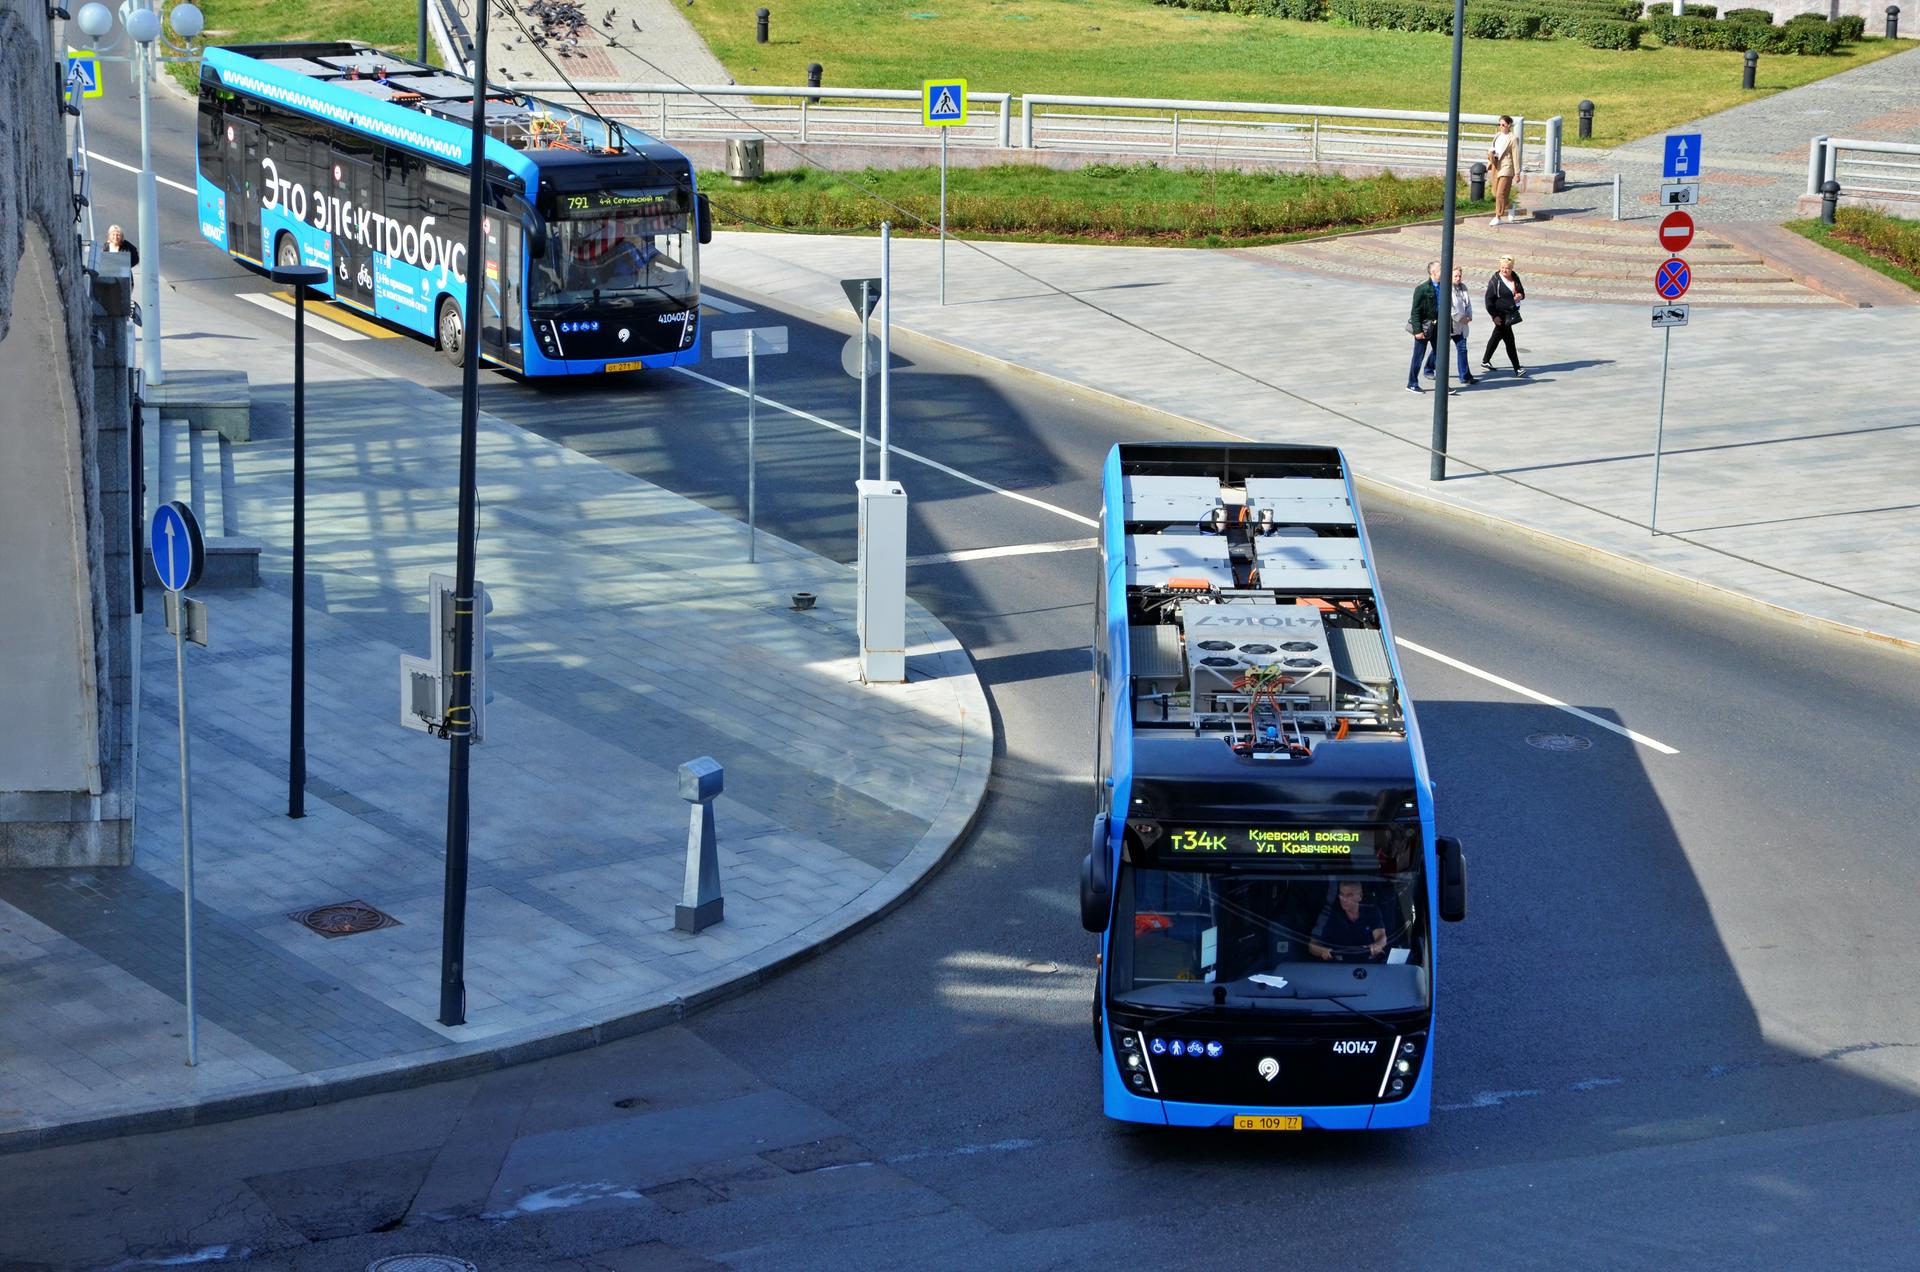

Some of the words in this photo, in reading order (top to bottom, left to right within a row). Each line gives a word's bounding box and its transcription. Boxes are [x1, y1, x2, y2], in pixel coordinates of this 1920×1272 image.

[567, 197, 589, 209] 791
[262, 157, 307, 222] Это
[313, 190, 466, 289] электробус
[658, 312, 685, 323] 410402
[1195, 616, 1321, 627] 410147
[1249, 829, 1310, 842] Киевский
[1315, 831, 1360, 842] вокзал
[1256, 842, 1277, 853] Ул.
[1282, 842, 1351, 855] Кравченко
[1332, 1040, 1378, 1054] 410147
[1259, 1118, 1280, 1128] 109
[1287, 1117, 1298, 1126] 77
